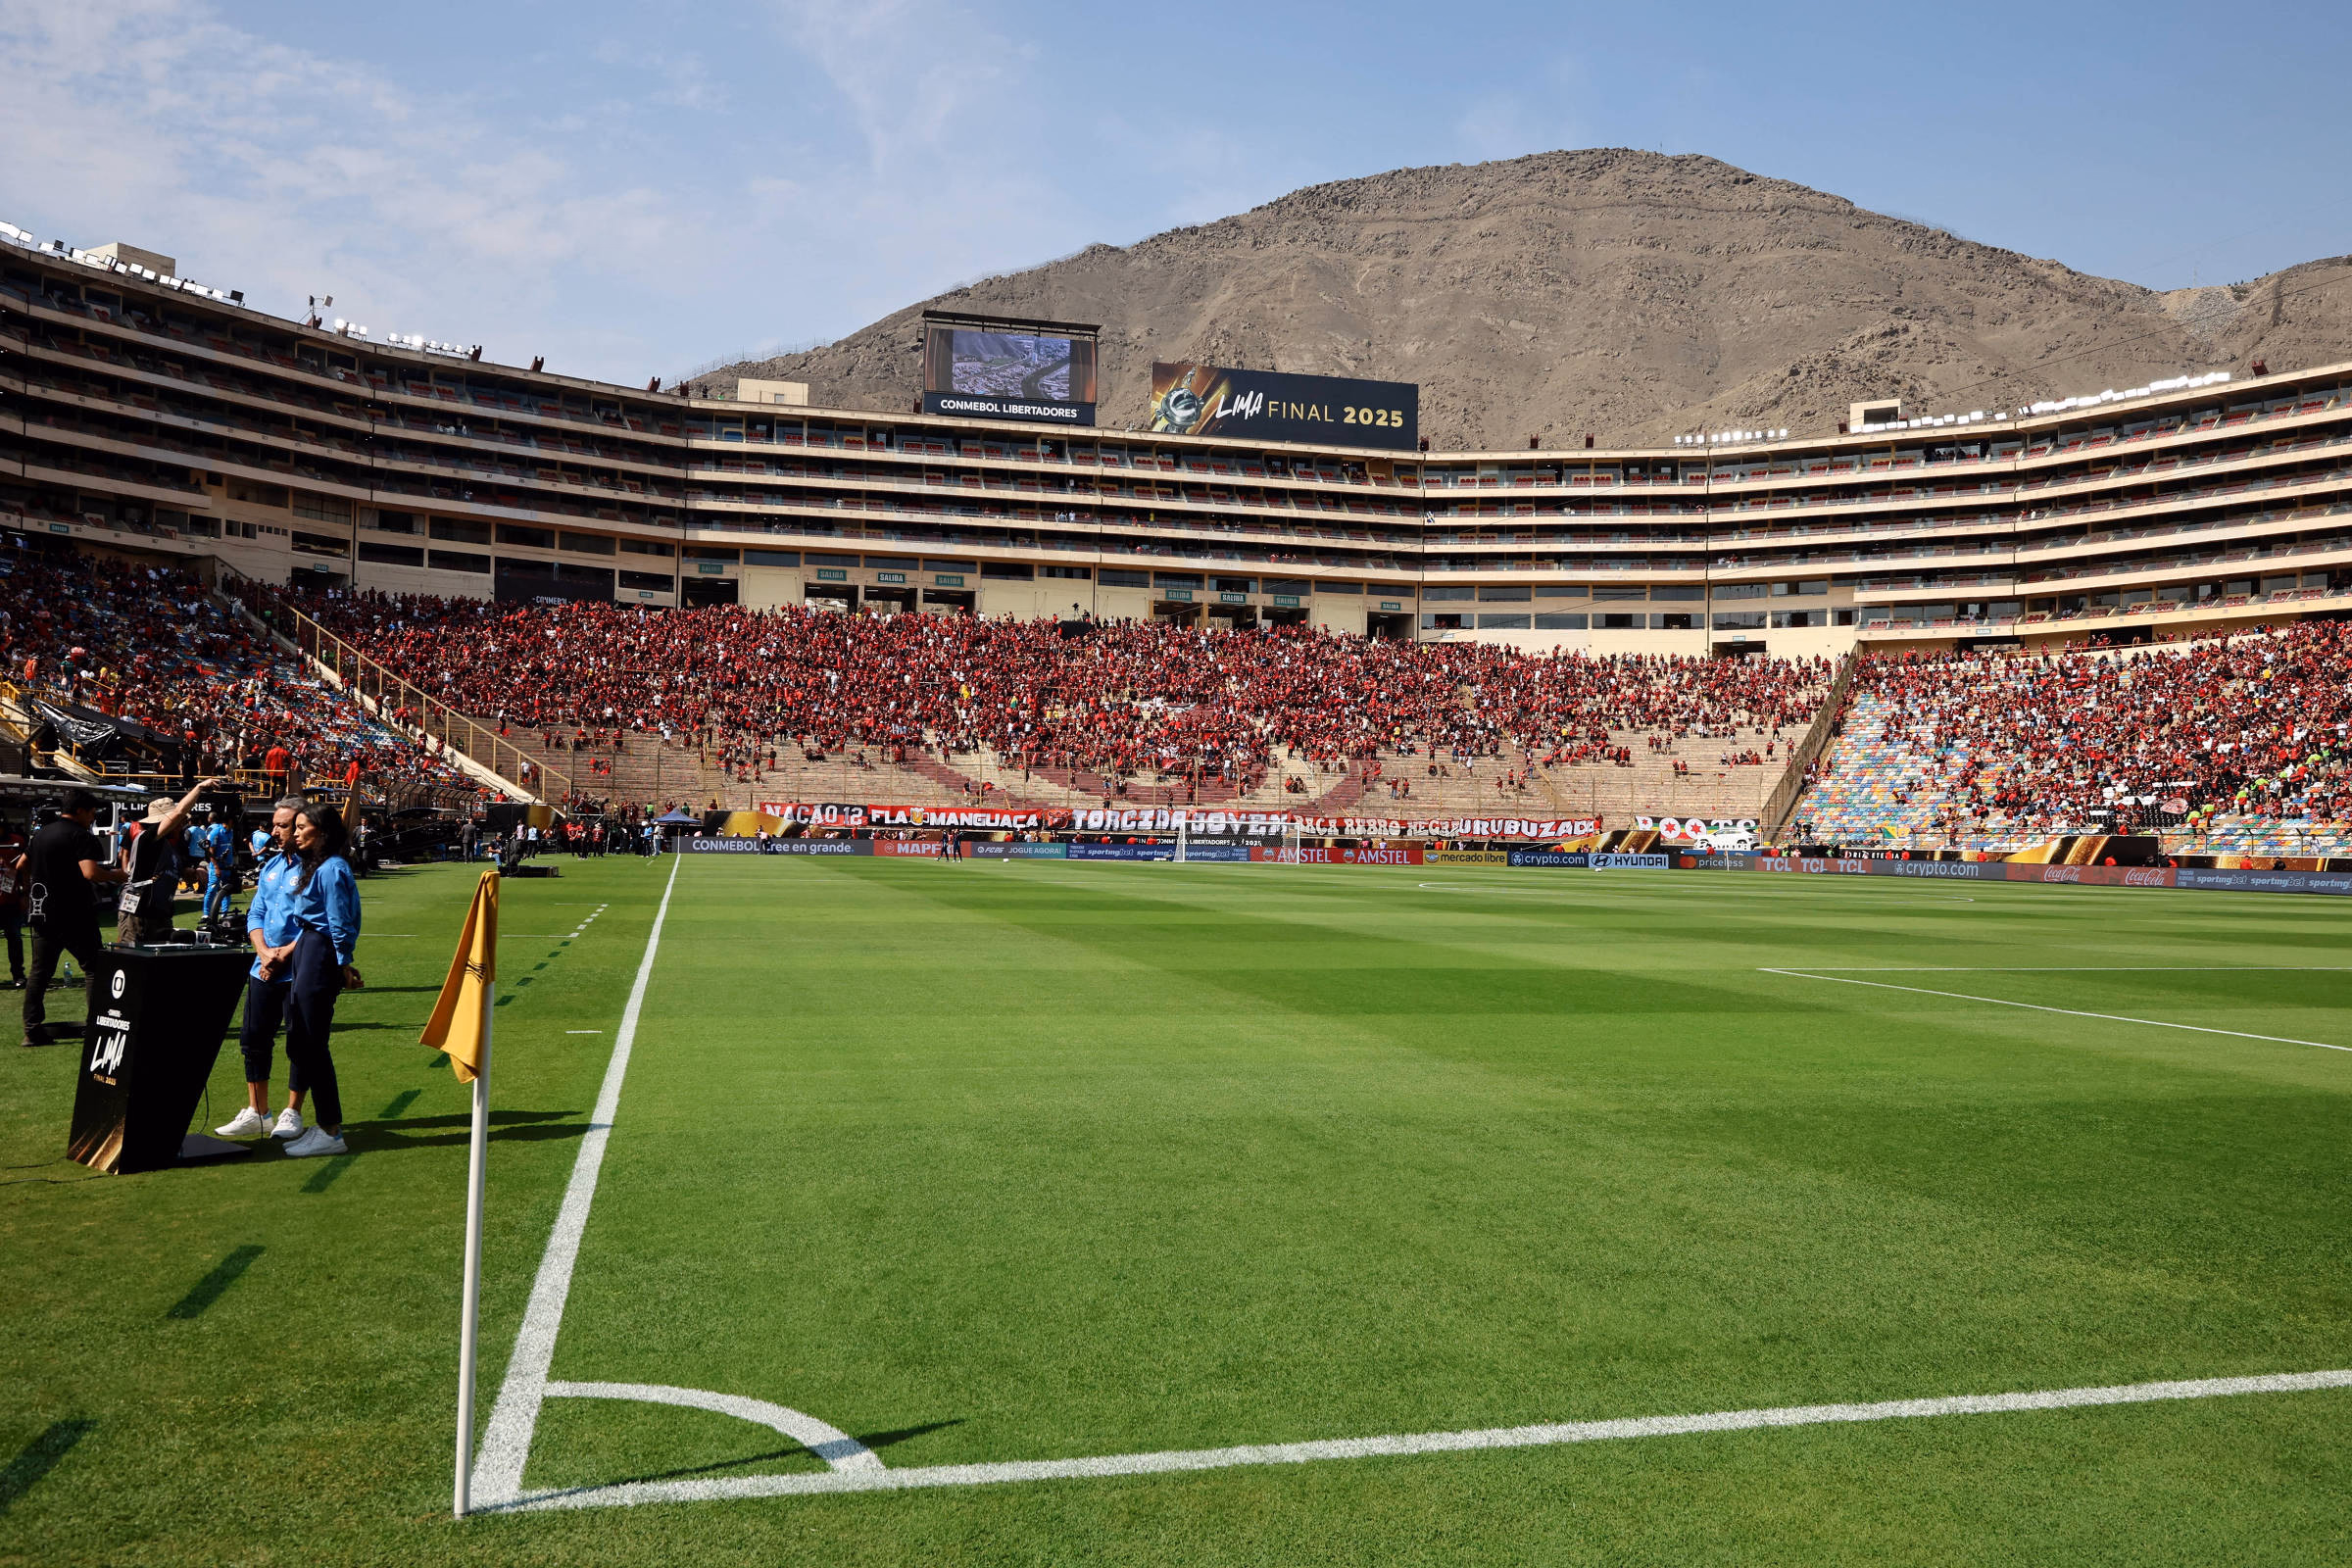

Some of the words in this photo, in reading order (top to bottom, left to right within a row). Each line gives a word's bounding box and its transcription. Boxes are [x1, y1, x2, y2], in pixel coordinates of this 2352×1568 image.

[940, 399, 1001, 413] CONMEBOL
[1003, 404, 1078, 418] LIBERTADORES
[1215, 390, 1263, 420] LIMA
[1267, 400, 1335, 422] FINAL
[1343, 406, 1403, 428] 2025
[819, 569, 845, 579] SALIDA
[879, 573, 904, 583] SALIDA
[938, 576, 962, 586] SALIDA
[1167, 590, 1191, 600] SALIDA
[1221, 593, 1245, 603] SALIDA
[1275, 597, 1298, 606] SALIDA
[843, 807, 863, 825] 12
[871, 808, 908, 824] FLA
[930, 811, 1039, 831] MANGUAÇA
[1072, 808, 1186, 831] TORCIDA
[692, 839, 760, 851] CONMEBOL
[1277, 848, 1332, 862] AMSTEL
[1357, 850, 1410, 863] AMSTEL
[1441, 853, 1483, 862] mercado
[1484, 852, 1505, 863] libre
[1524, 855, 1585, 866] crypto.com
[1614, 856, 1668, 867] HYUNDAI
[1698, 858, 1744, 868] priceless
[1762, 858, 1792, 872] TCL
[1800, 858, 1828, 873] TCL
[1838, 859, 1867, 873] TCL
[1906, 861, 1979, 878] crypto.com
[96, 1015, 130, 1032] LIBERTADORES
[90, 1031, 126, 1075] LIMA
